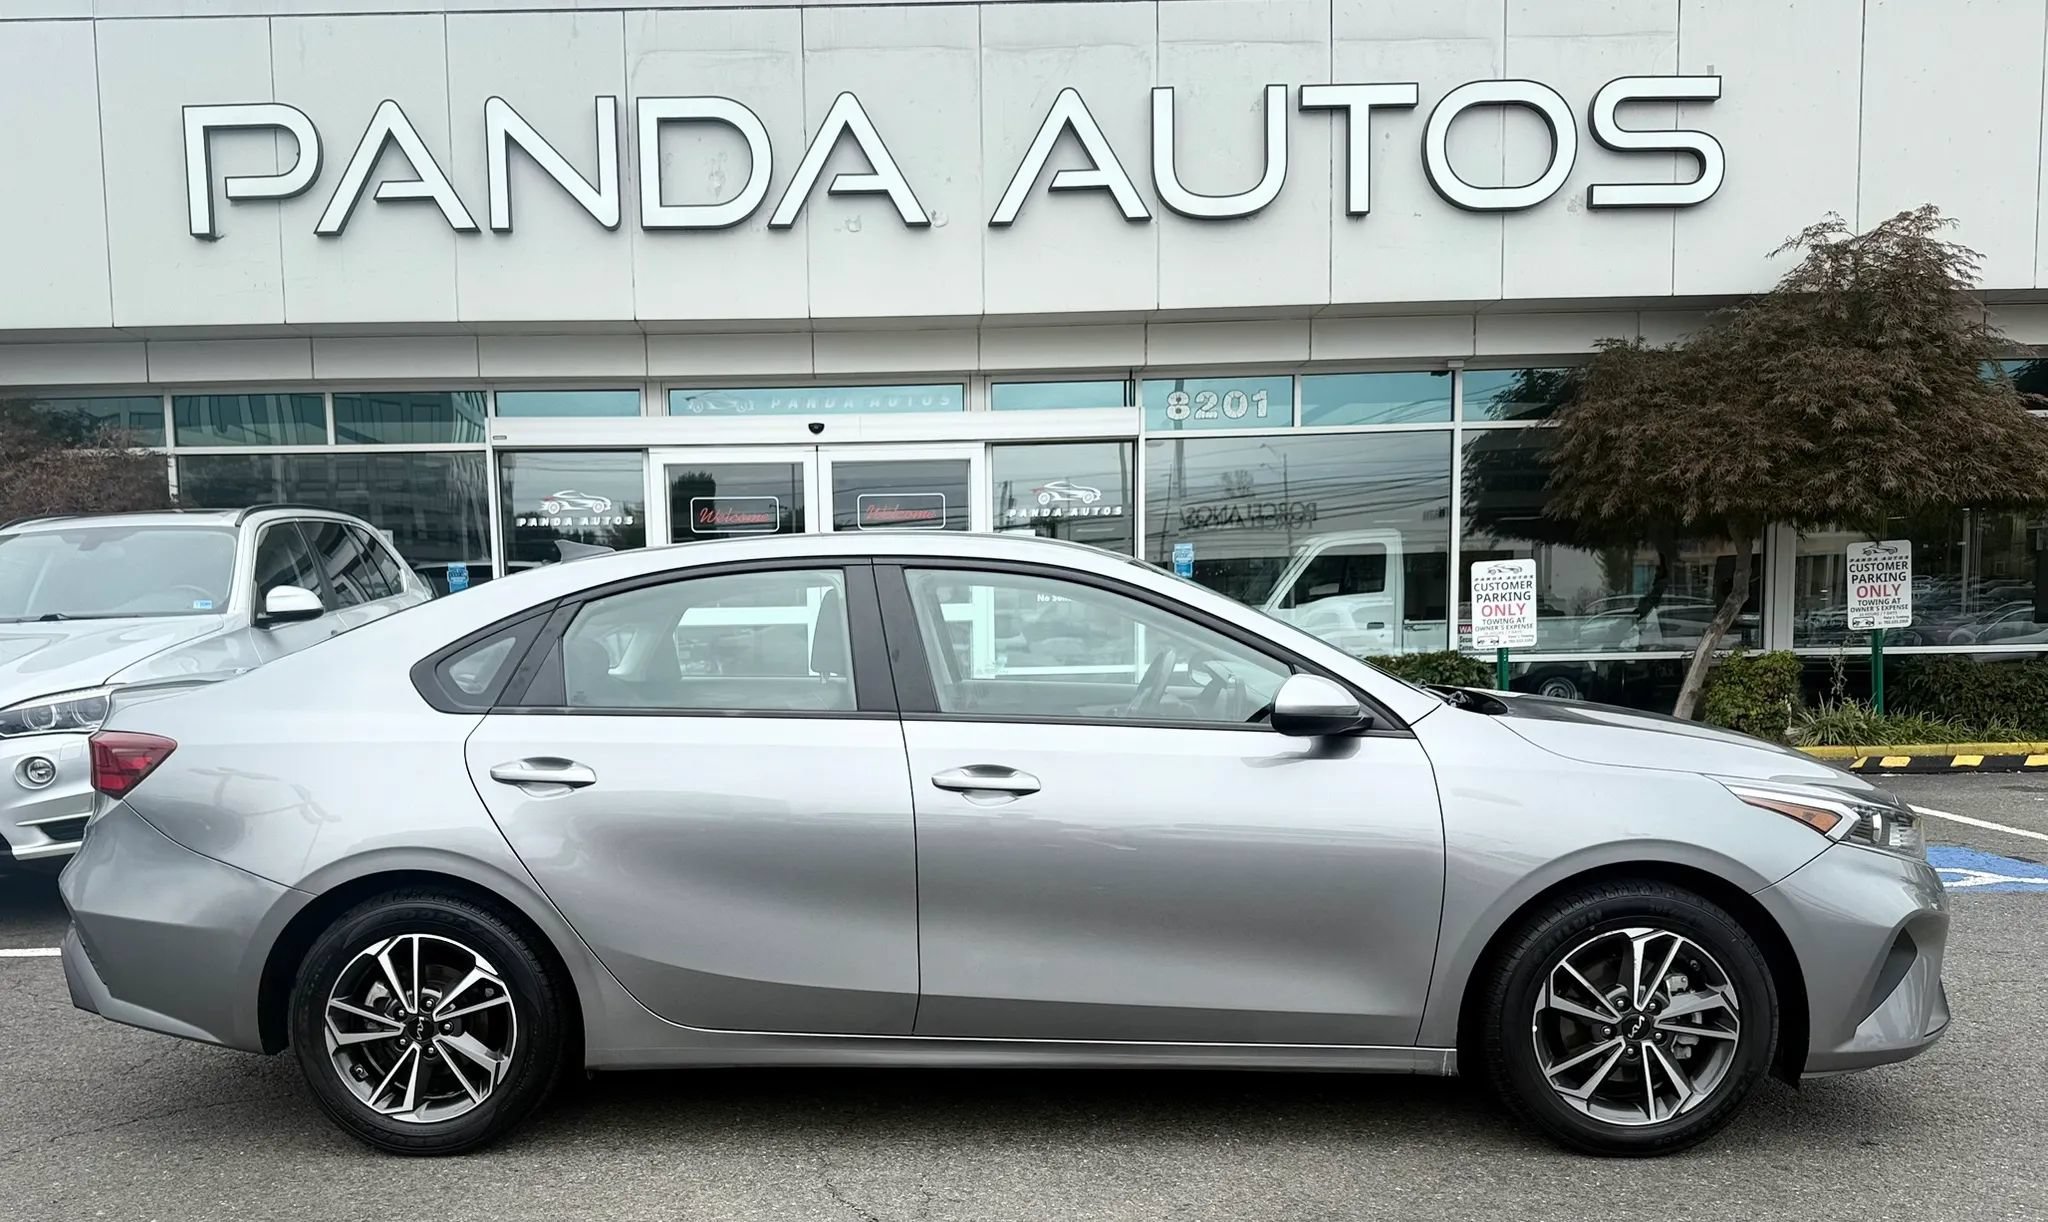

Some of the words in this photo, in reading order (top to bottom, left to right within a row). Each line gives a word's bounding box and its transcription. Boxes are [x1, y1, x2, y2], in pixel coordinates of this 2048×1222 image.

[181, 90, 932, 239] PANDA
[988, 75, 1726, 226] AUTOS
[770, 397, 855, 409] PANDA
[1166, 389, 1269, 420] 8201
[698, 507, 769, 524] Welcome
[866, 503, 937, 521] Welcome
[1009, 508, 1062, 518] PANDA
[1070, 506, 1123, 516] AUTOS
[516, 517, 573, 527] PANDA
[580, 516, 634, 526] AUTOS
[1849, 561, 1909, 573] CUSTOMER
[1851, 571, 1907, 584] PARKING
[1474, 580, 1533, 592] CUSTOMER
[1856, 584, 1902, 598] ONLY
[1476, 591, 1531, 603] PARKING
[1857, 598, 1890, 607] TOWING
[1891, 597, 1902, 605] AT
[1481, 603, 1526, 617] ONLY
[1482, 617, 1515, 625] TOWING
